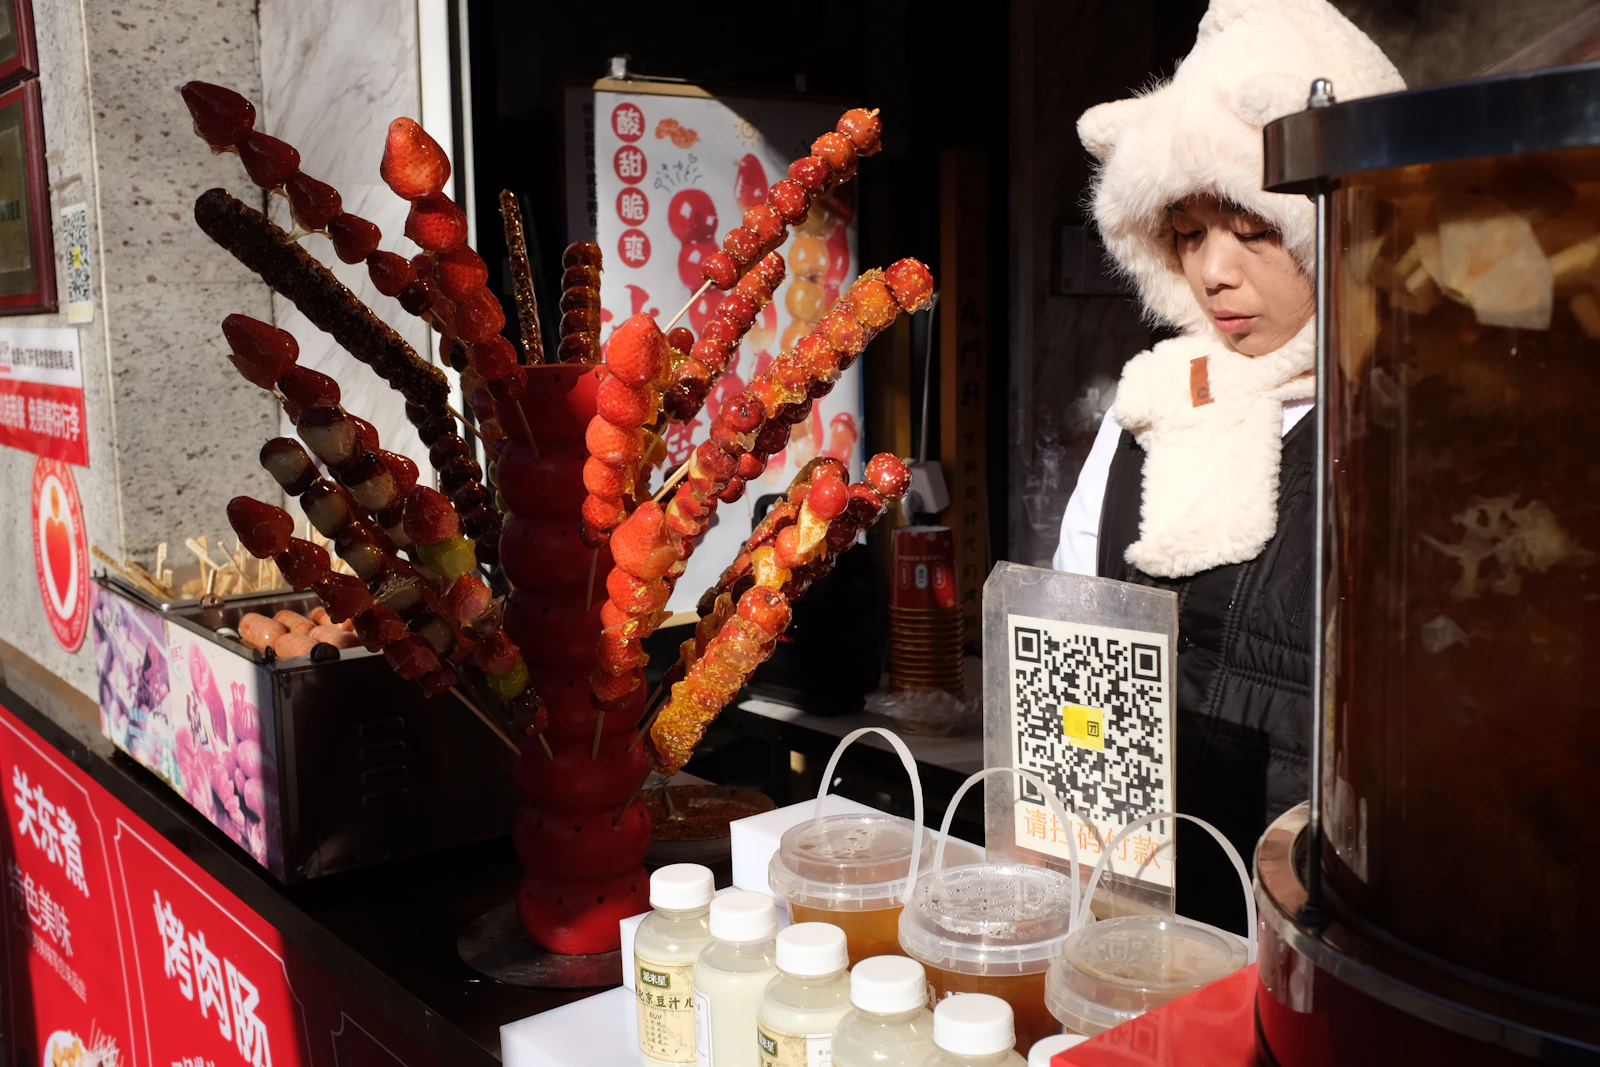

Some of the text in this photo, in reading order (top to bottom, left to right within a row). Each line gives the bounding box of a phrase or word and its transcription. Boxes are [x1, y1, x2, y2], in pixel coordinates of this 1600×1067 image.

[616, 108, 645, 262] 酸甜脆爽
[13, 765, 89, 898] 关东煮
[1024, 808, 1161, 869] 请扫码付款
[153, 889, 272, 1067] 烤肉肠
